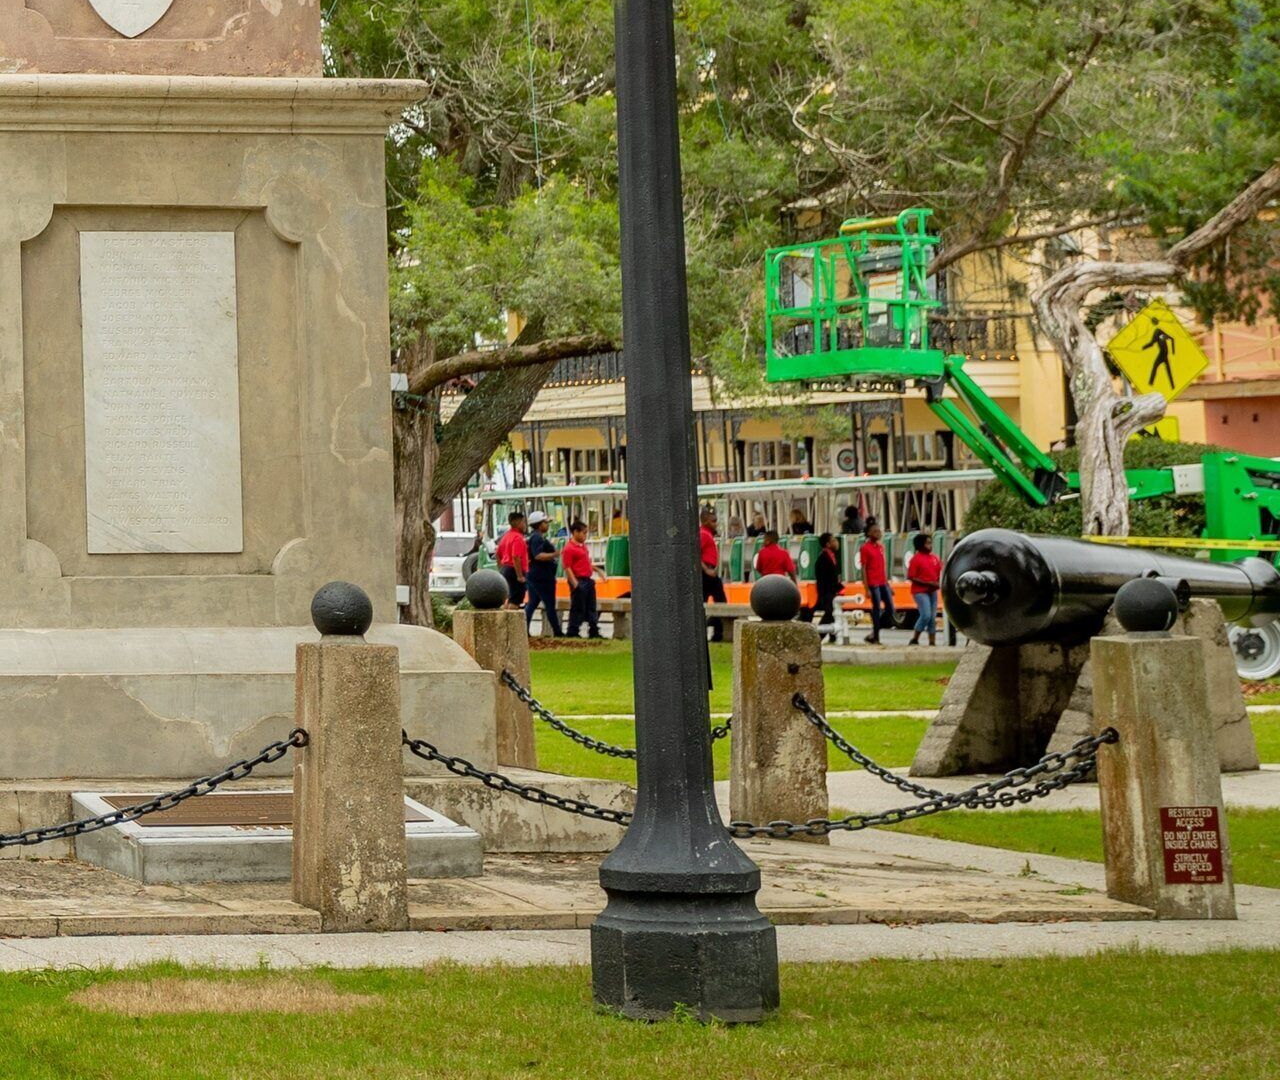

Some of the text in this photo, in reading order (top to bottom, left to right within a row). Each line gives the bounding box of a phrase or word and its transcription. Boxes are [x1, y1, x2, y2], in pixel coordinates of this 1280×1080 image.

[1168, 808, 1212, 818] RESTRICTED
[1176, 817, 1205, 827] ACCESS
[1164, 831, 1217, 840] DO NOT ENTER
[1165, 840, 1218, 849] INSIDE CHAINS
[1175, 853, 1209, 863] STRICTLY
[1173, 862, 1212, 872] ENFORCED
